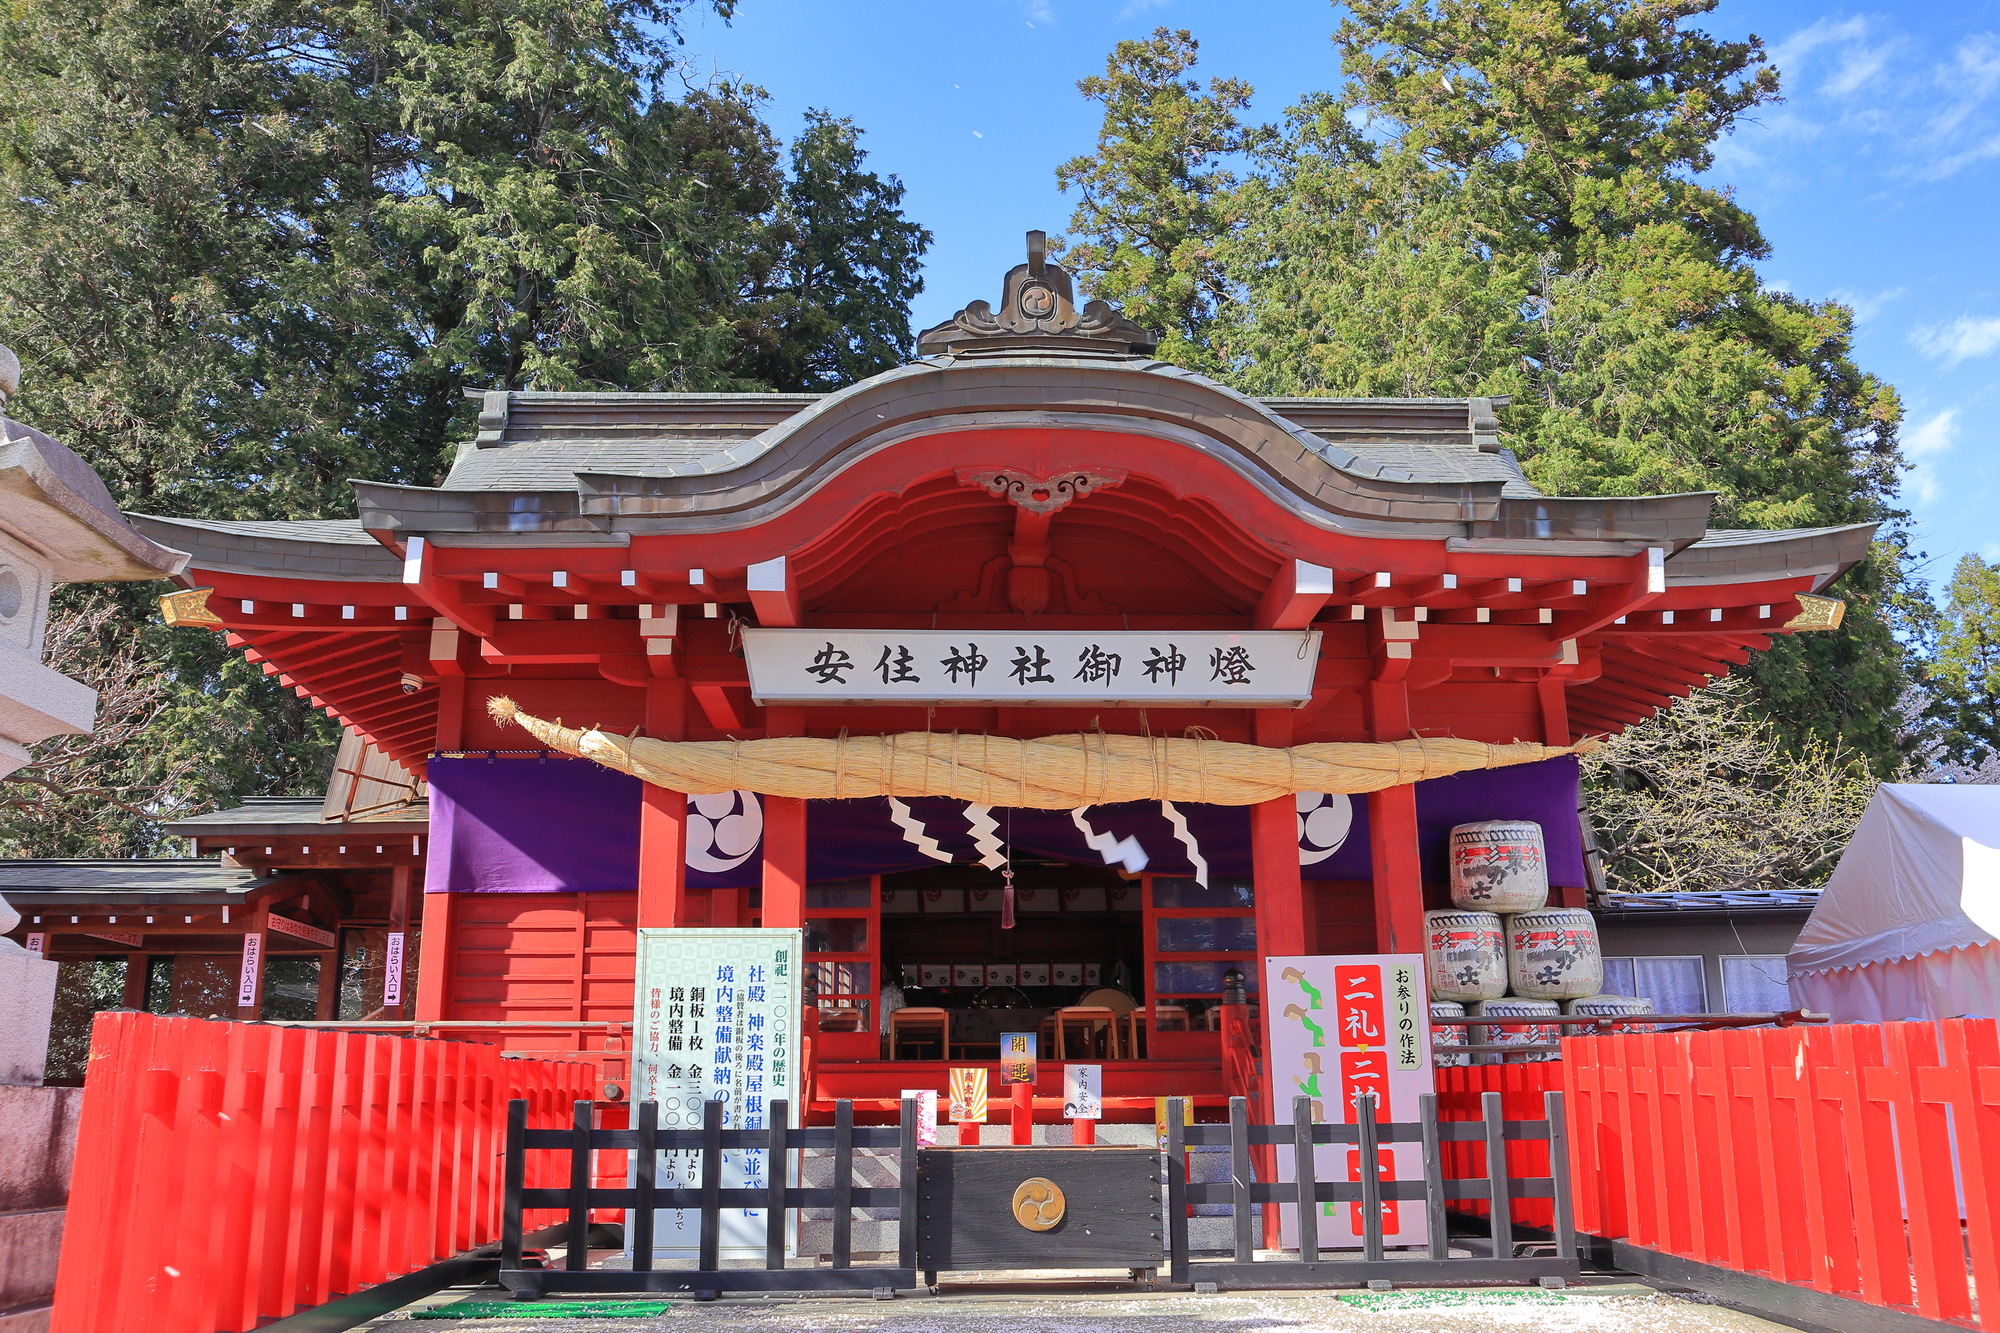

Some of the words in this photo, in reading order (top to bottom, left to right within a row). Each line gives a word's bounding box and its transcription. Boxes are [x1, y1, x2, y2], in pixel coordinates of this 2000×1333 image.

[804, 642, 1257, 688] 安住神社御神燈
[243, 937, 257, 993] おはらい入口
[387, 937, 401, 993] おはらい入口
[747, 964, 766, 1003] 社殿
[668, 987, 685, 1051] 境内整備
[1343, 977, 1379, 1039] 二礼
[1396, 969, 1416, 1064] お参りの作法
[1011, 1036, 1030, 1082] 開運
[964, 1072, 974, 1119] 商売繁盛
[1078, 1067, 1089, 1114] 家内安全
